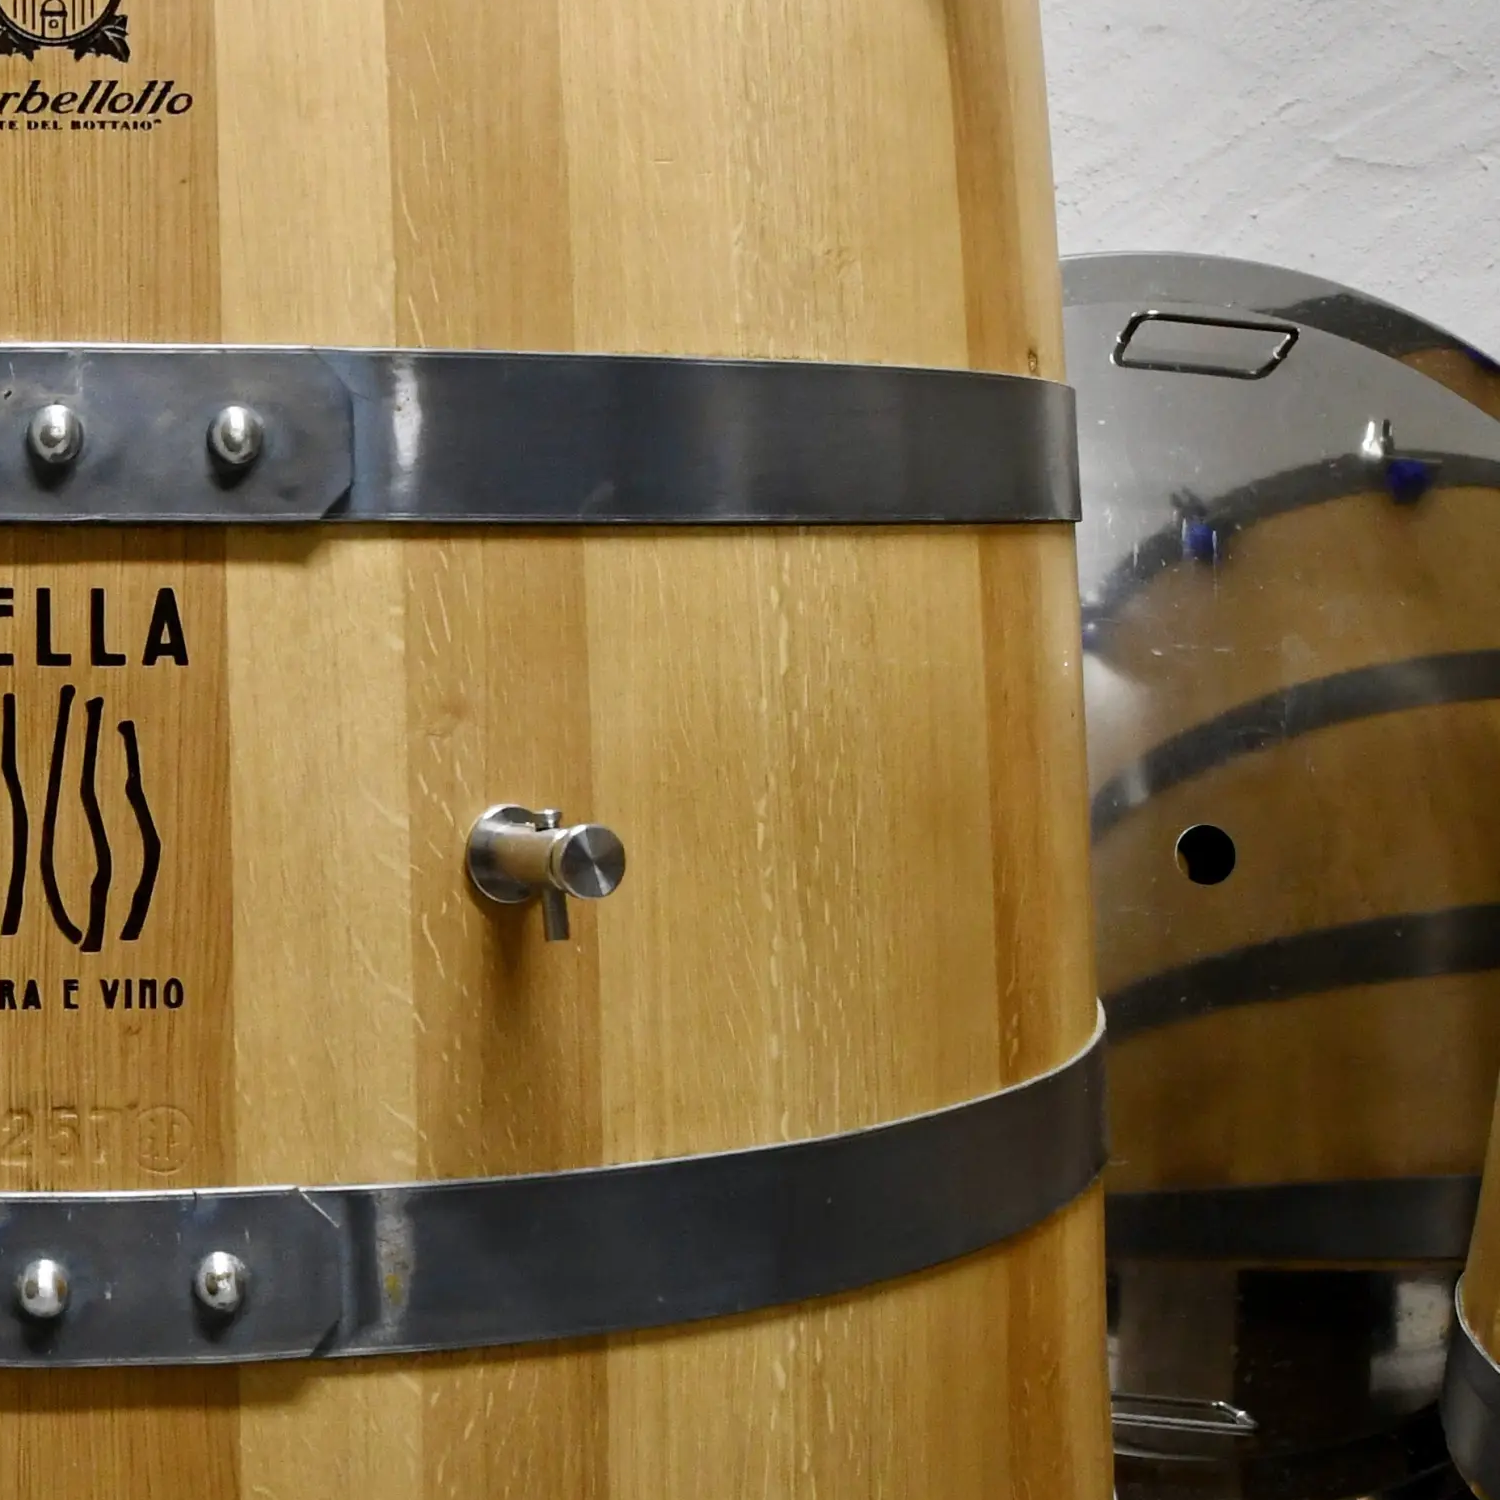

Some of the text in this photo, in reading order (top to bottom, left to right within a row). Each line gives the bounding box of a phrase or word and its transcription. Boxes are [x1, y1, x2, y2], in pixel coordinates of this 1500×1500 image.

[27, 119, 63, 130] DEL
[63, 979, 79, 1010] E
[99, 977, 184, 1010] VINO
